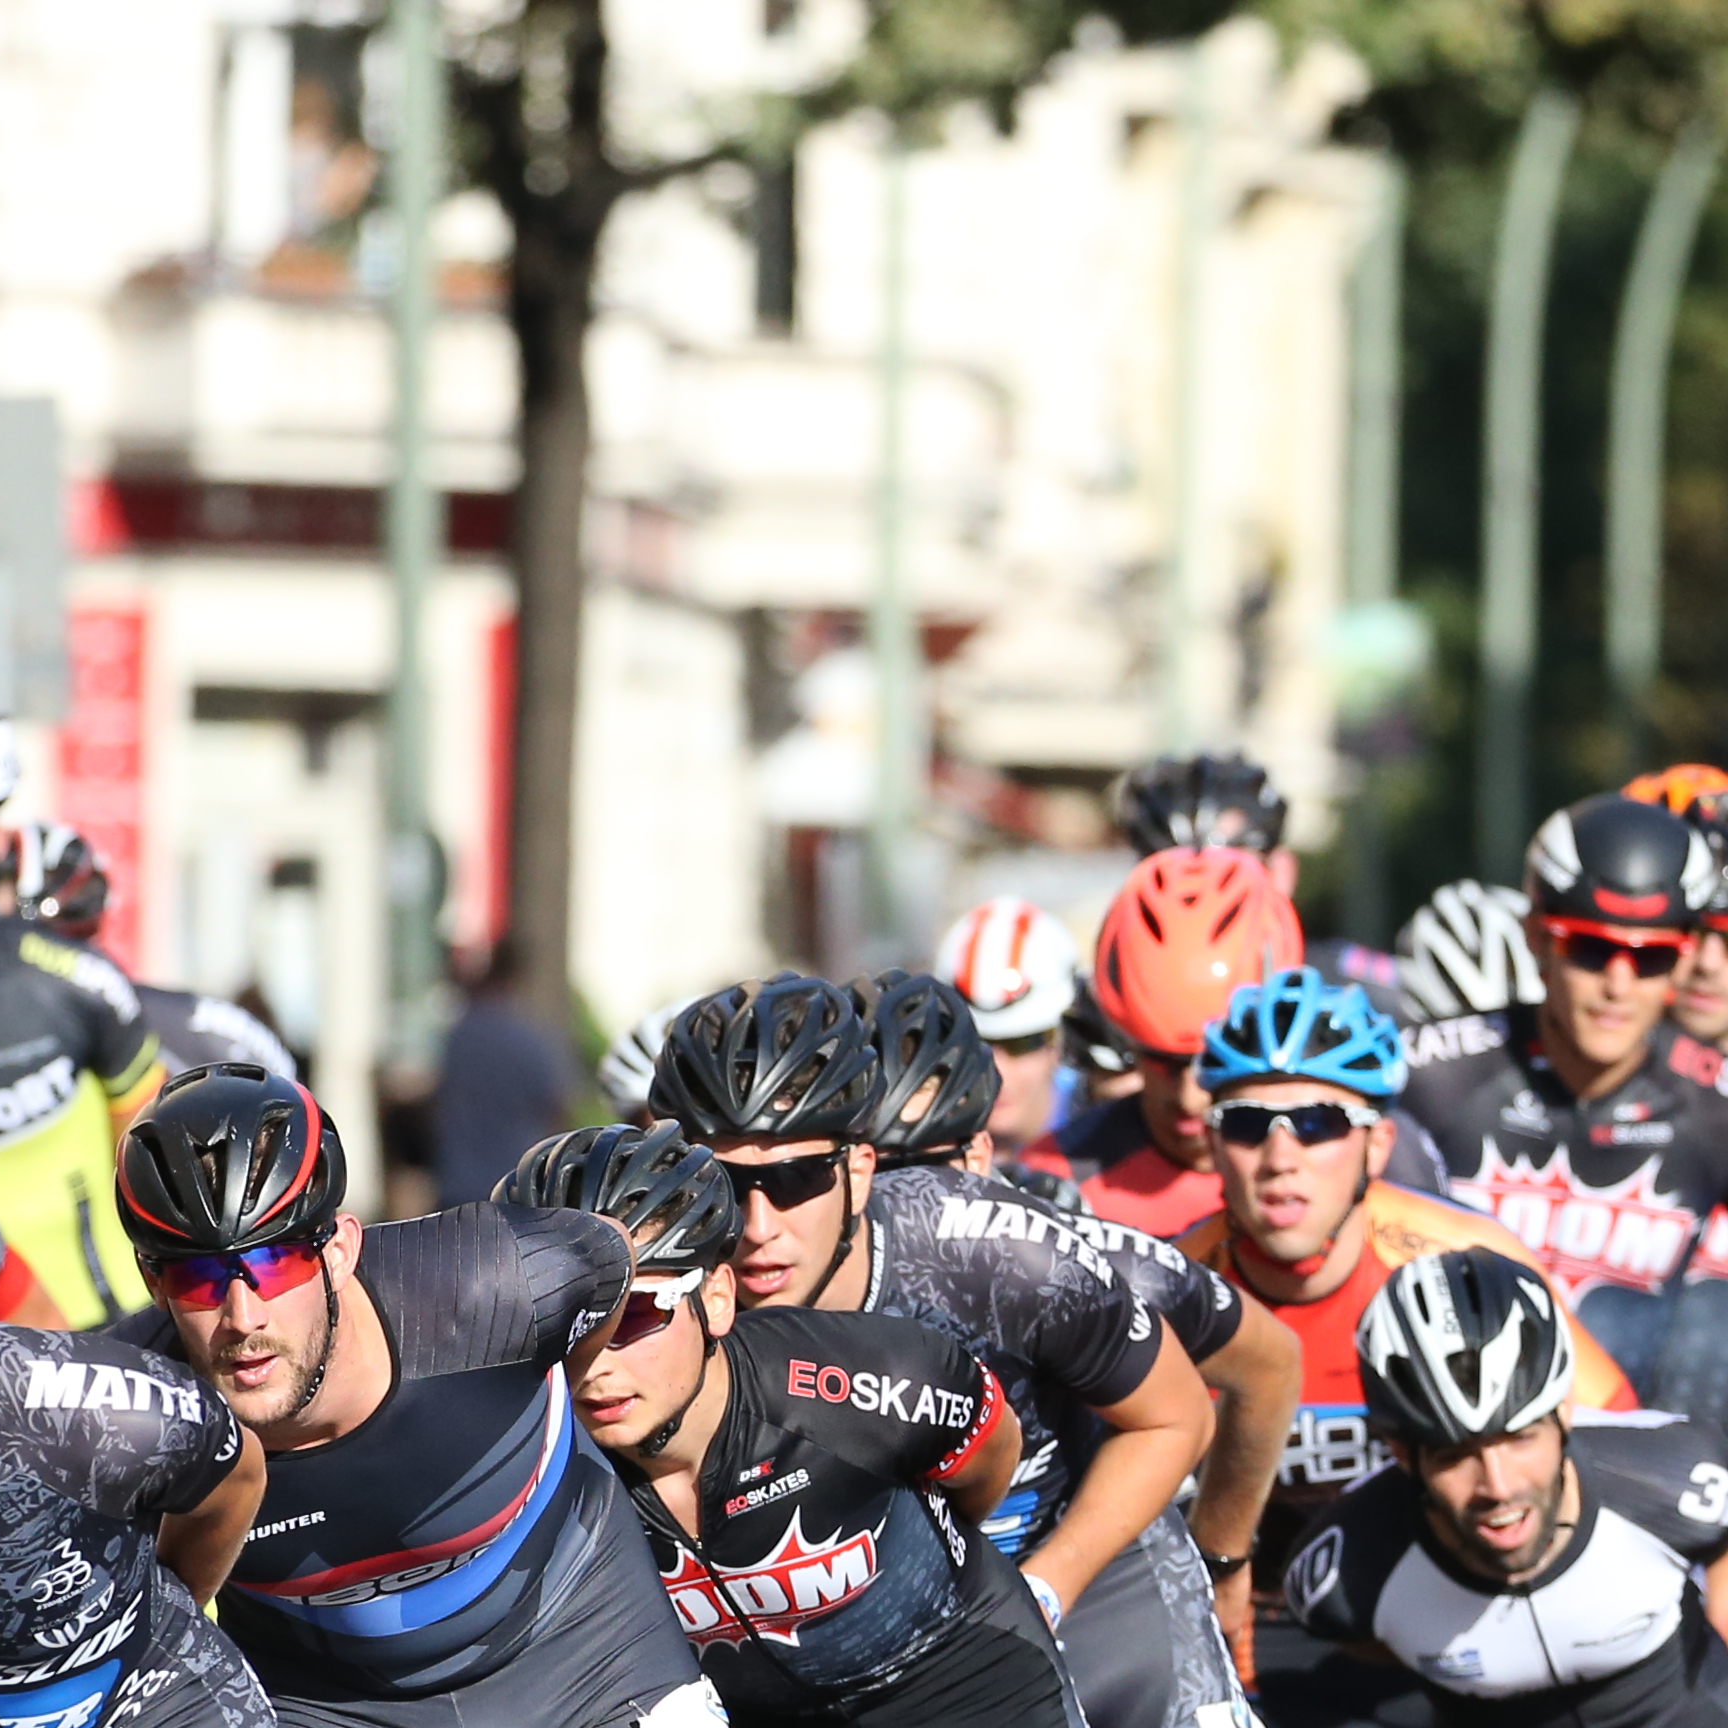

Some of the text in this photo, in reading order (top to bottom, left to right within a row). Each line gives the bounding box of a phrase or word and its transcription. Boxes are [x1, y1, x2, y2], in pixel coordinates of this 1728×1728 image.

[788, 1359, 973, 1429] EOSKATES
[725, 1468, 810, 1515] EOSKATES
[244, 1510, 326, 1542] HUNTER
